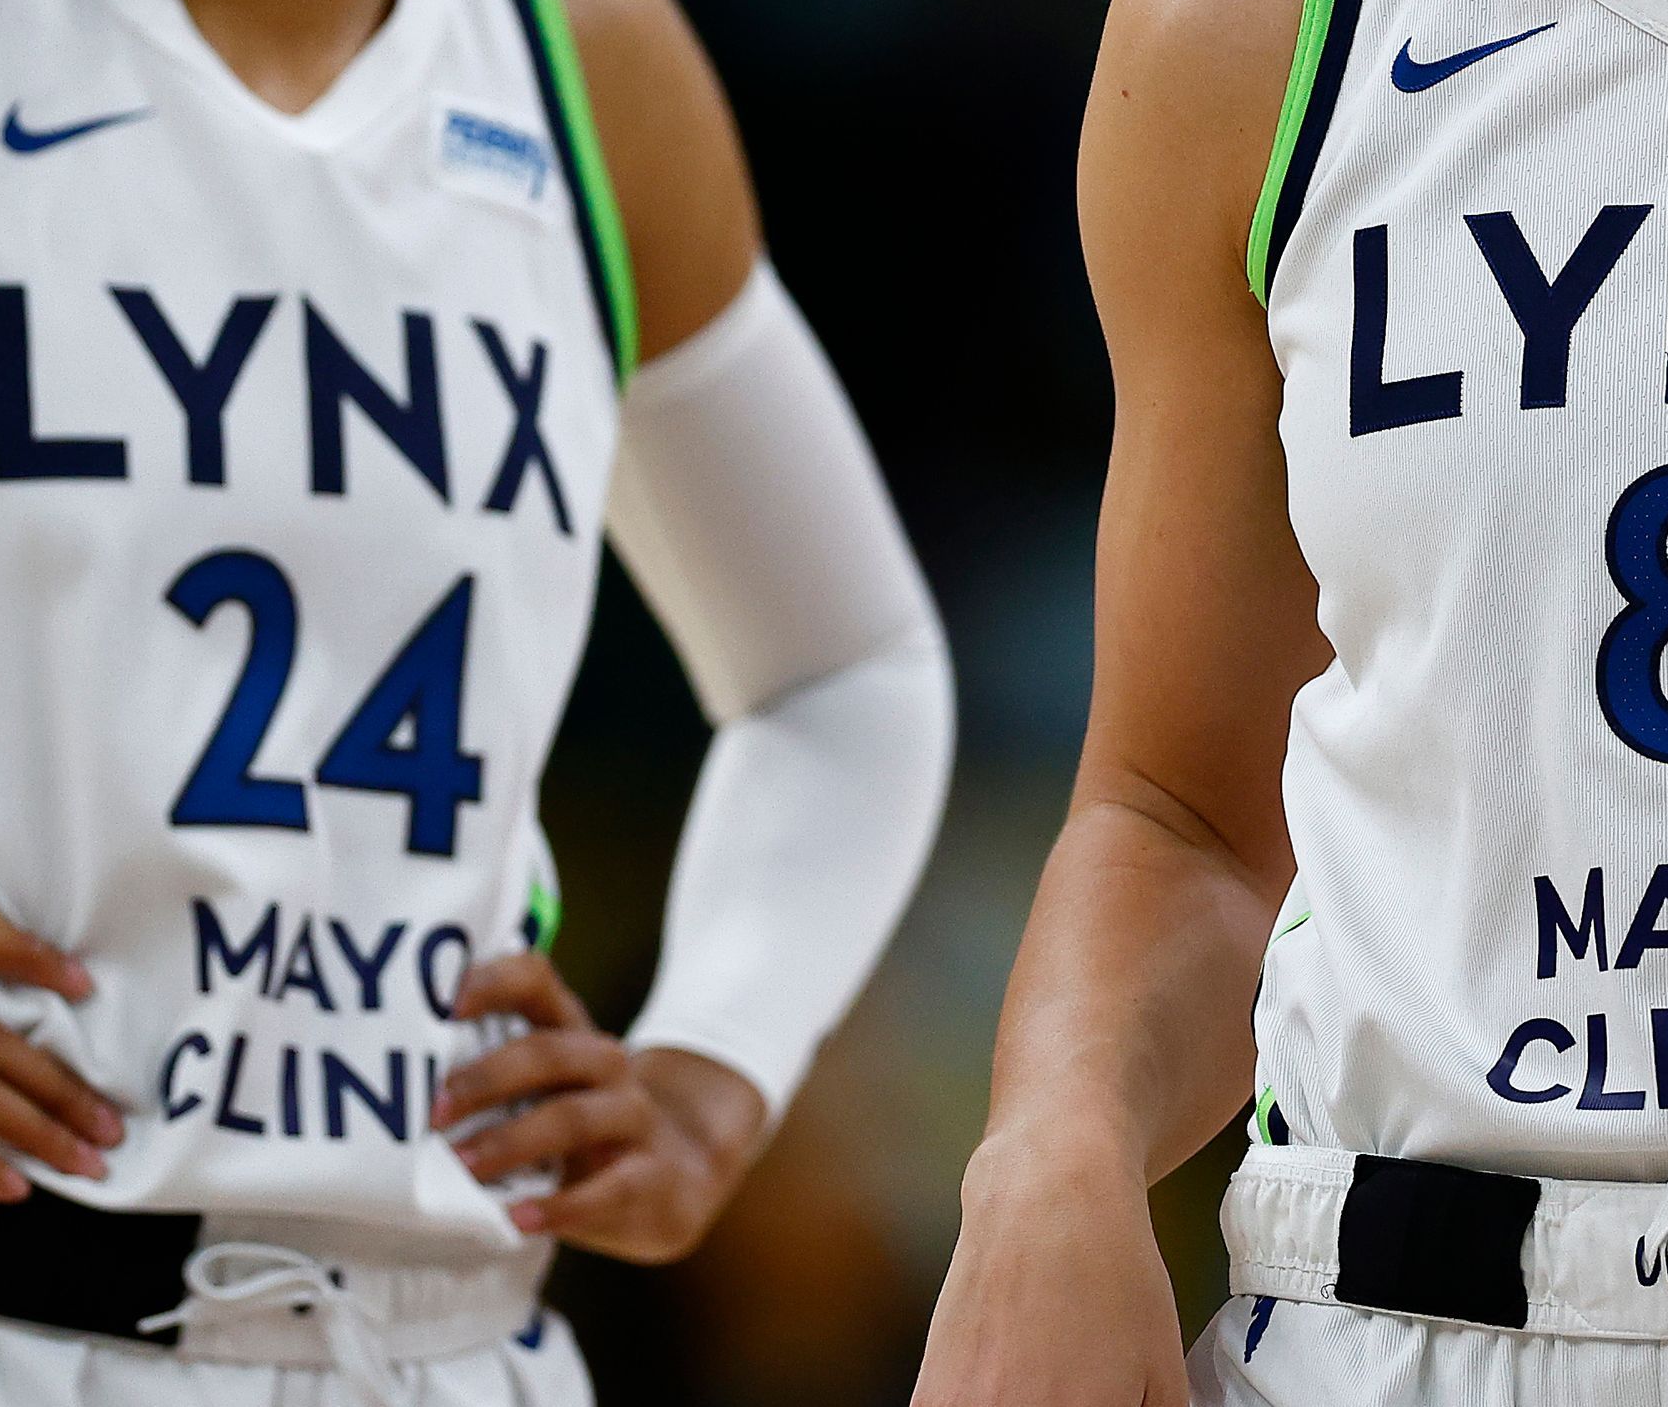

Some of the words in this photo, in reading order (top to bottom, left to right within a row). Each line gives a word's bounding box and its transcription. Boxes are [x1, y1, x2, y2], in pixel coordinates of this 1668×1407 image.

[162, 546, 486, 862] 24
[190, 895, 474, 1021] MAYO
[160, 1030, 438, 1143] CLIN
